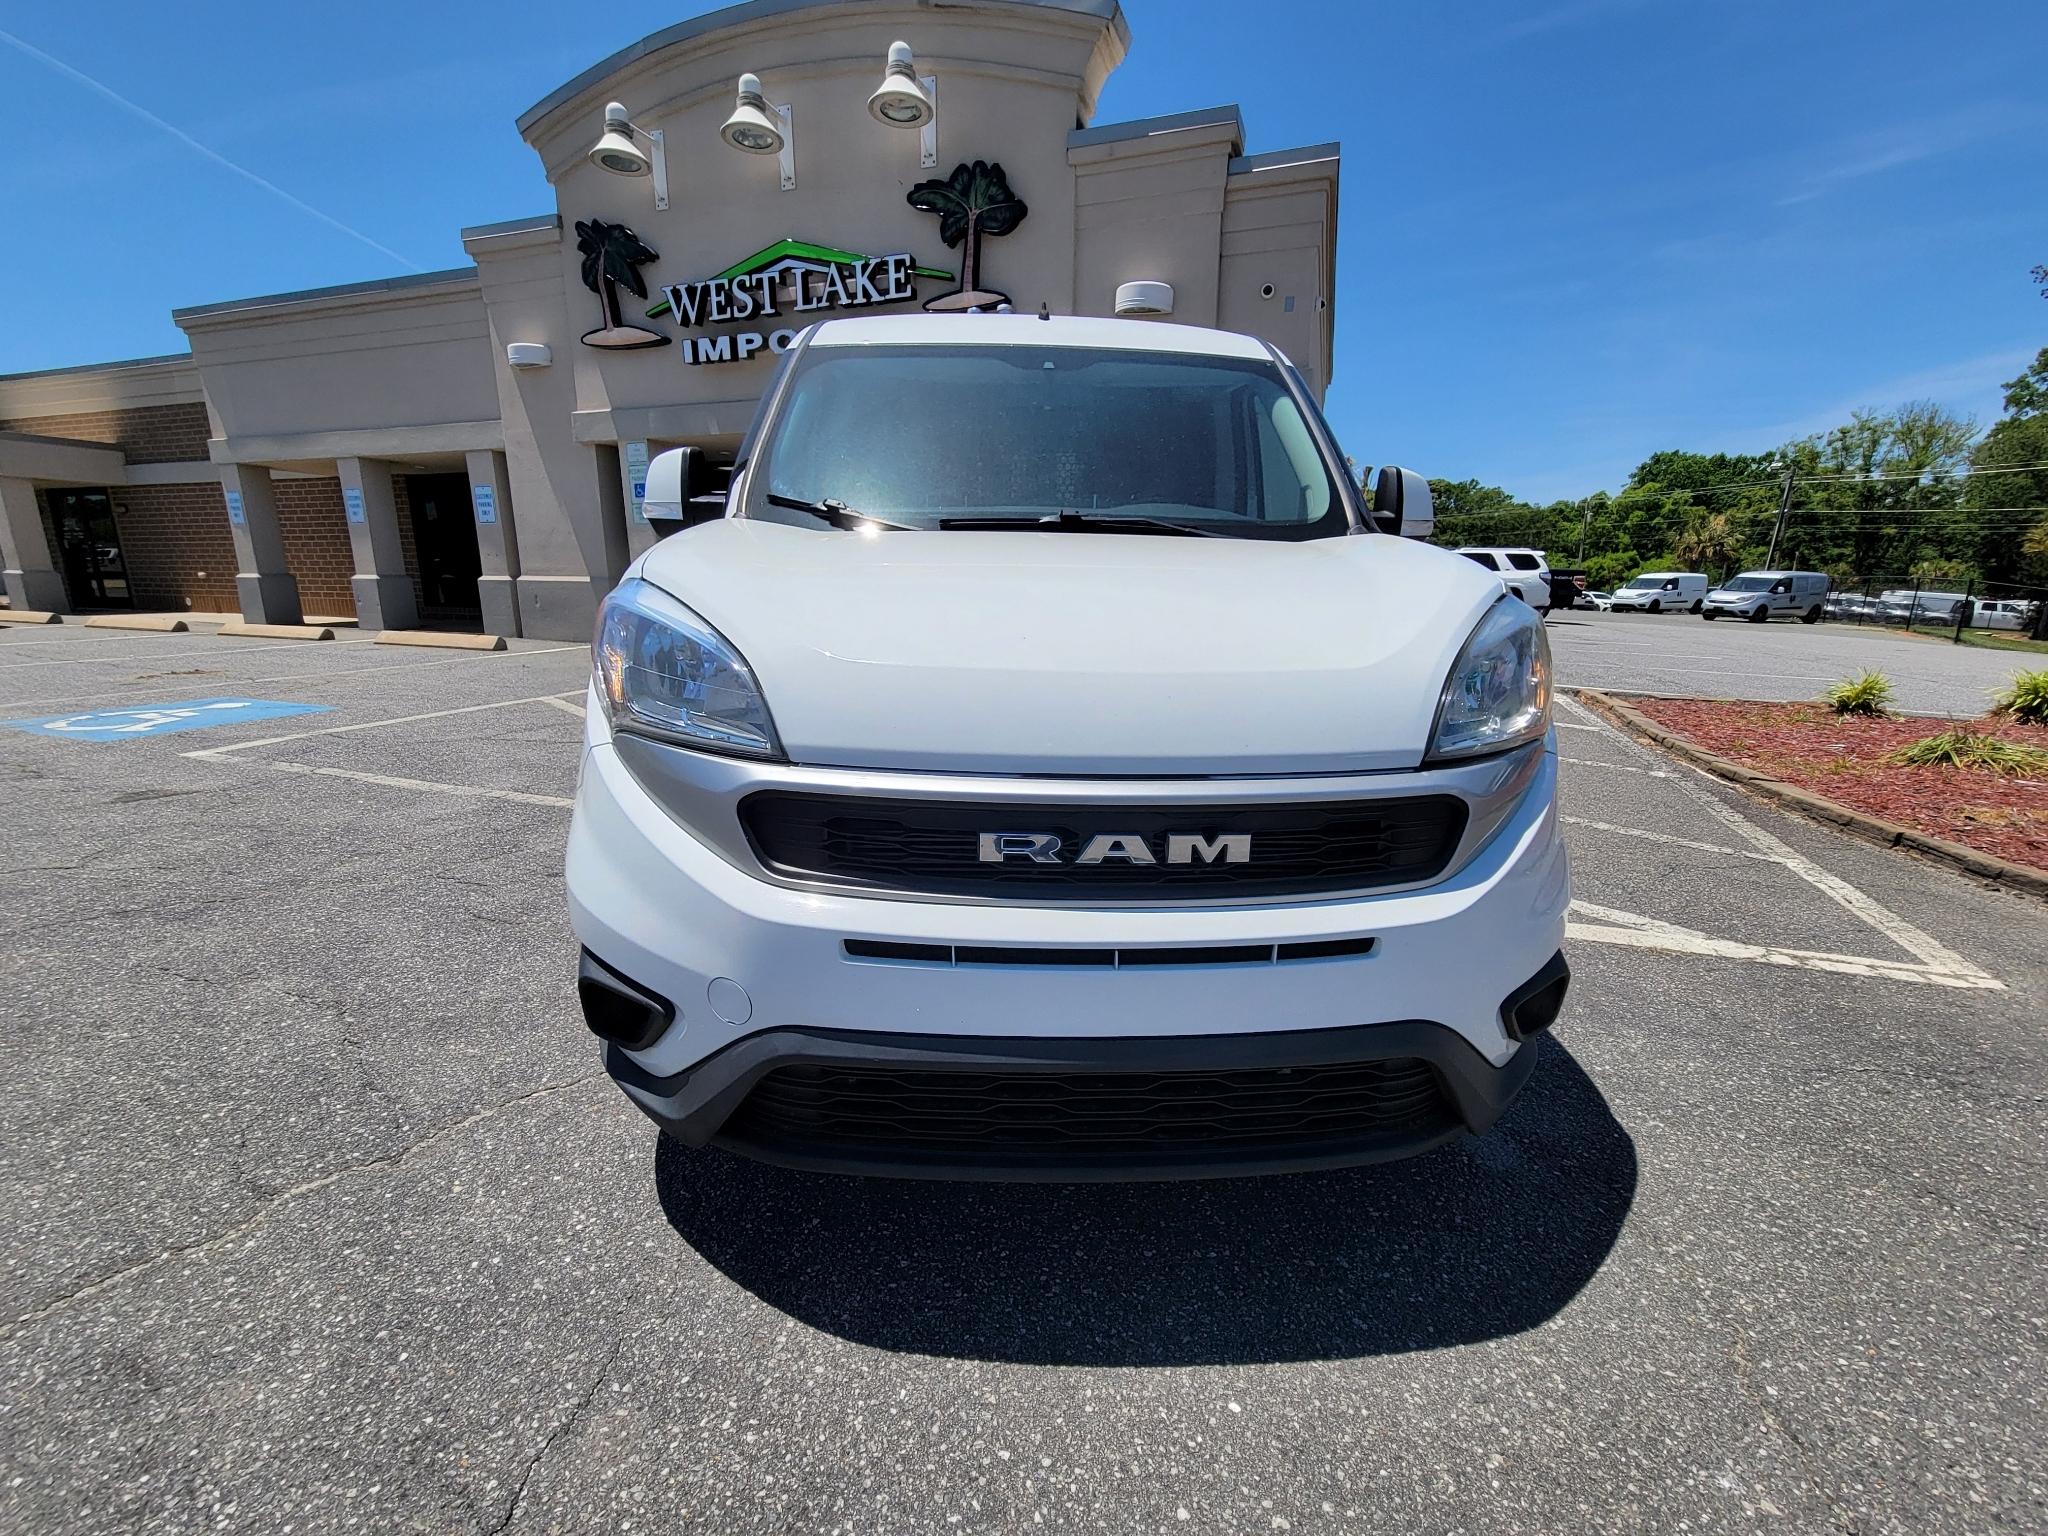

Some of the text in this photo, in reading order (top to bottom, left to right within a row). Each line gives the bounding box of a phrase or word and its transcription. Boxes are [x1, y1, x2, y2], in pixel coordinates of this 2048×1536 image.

[660, 253, 912, 326] WEST LAKE
[979, 832, 1252, 864] RAM
